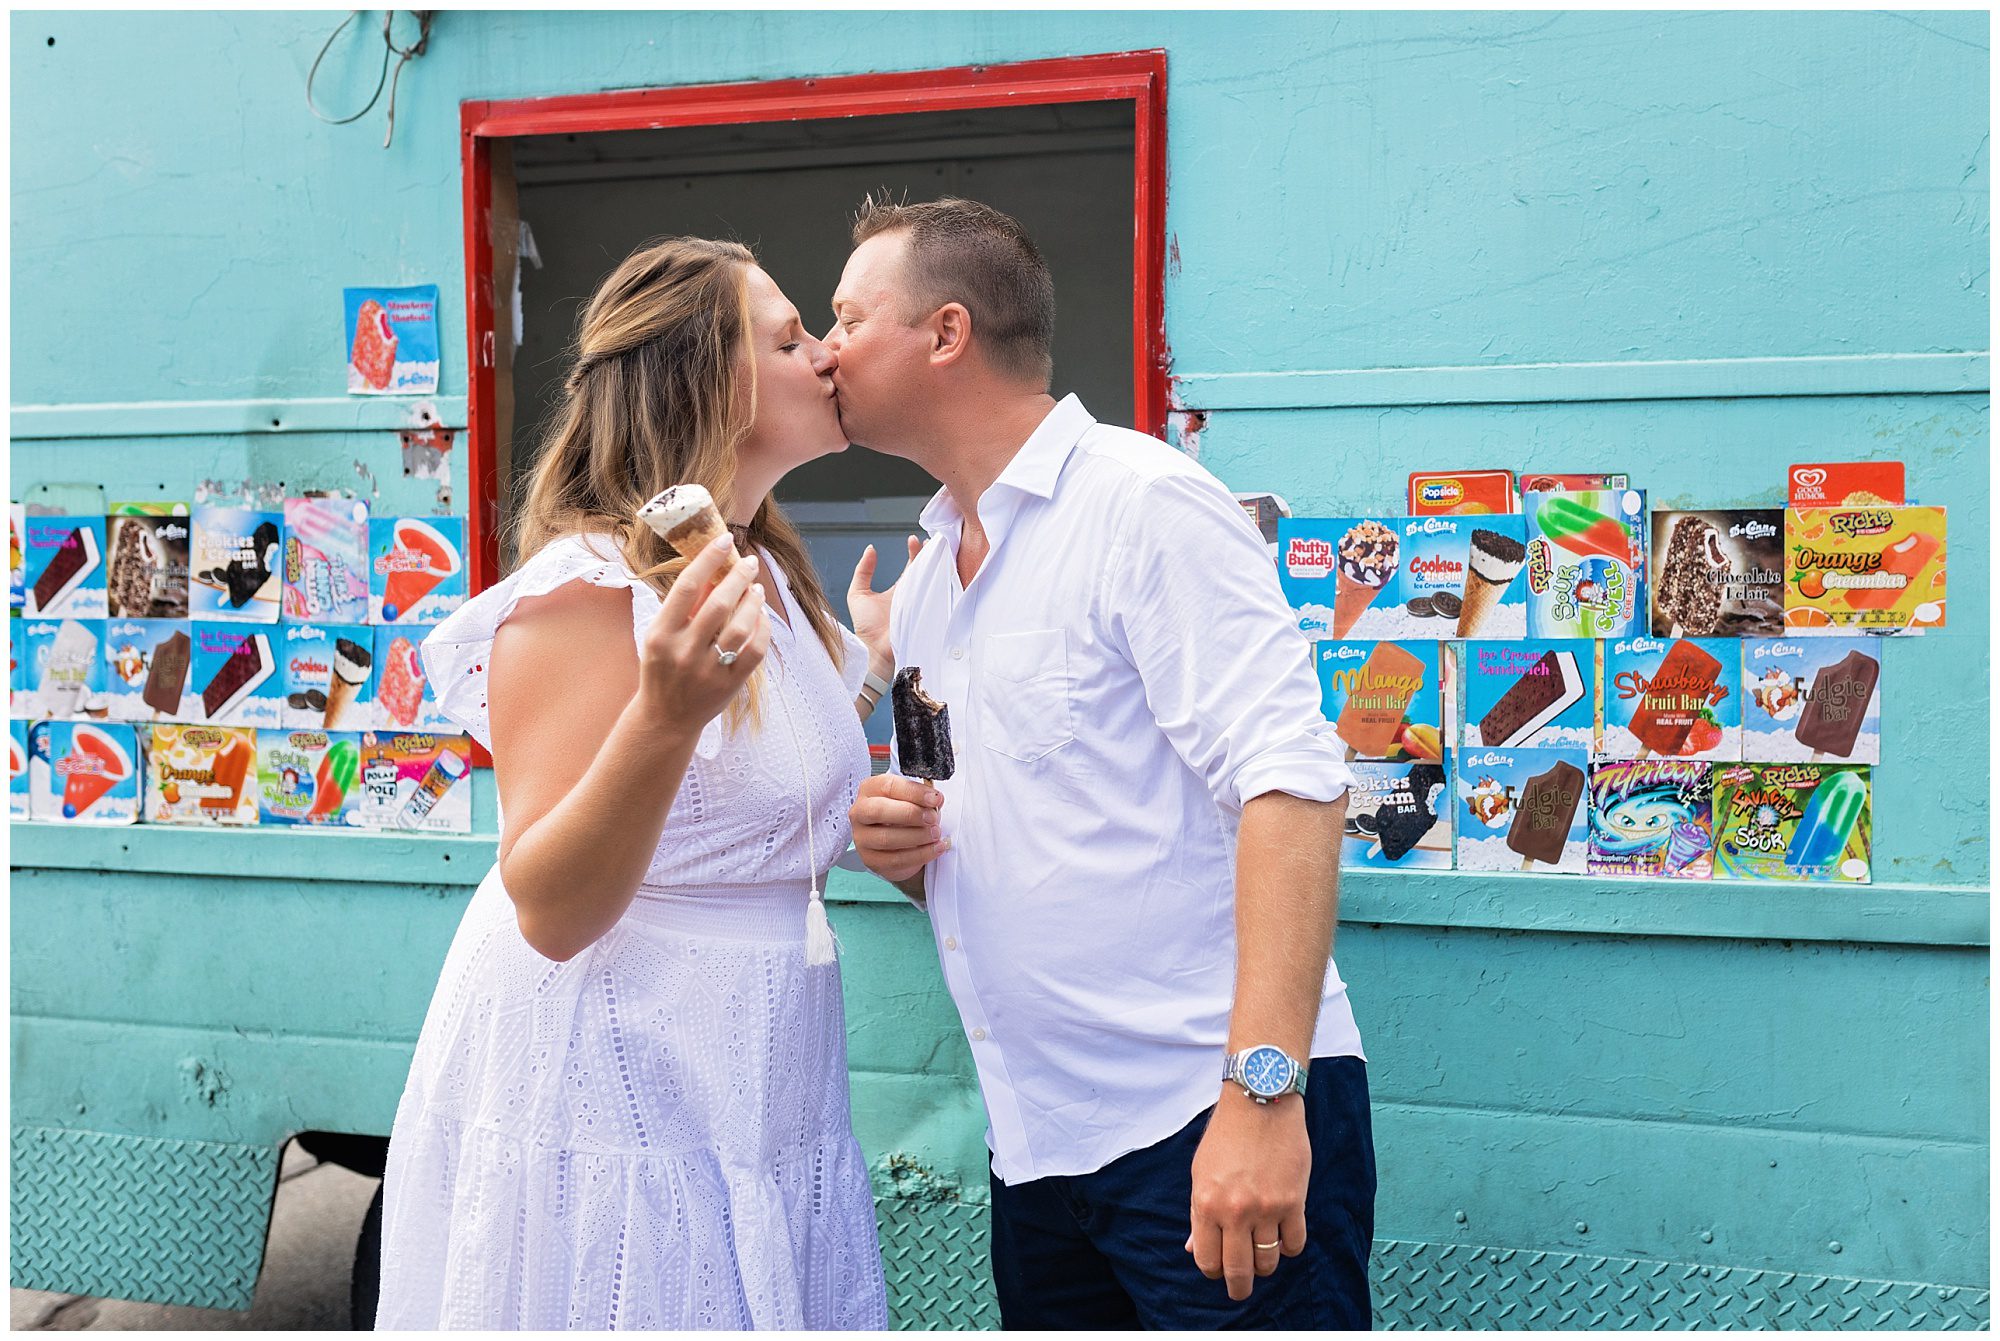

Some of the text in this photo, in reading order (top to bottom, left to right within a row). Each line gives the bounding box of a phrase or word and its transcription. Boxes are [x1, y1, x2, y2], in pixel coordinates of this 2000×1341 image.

[1422, 486, 1459, 499] Popsicle
[1794, 492, 1826, 500] HUMOR
[1832, 510, 1893, 538] Rich's
[1292, 541, 1329, 557] Nutty
[1288, 554, 1333, 569] Buddy
[1409, 554, 1463, 573] Cookies
[1528, 539, 1553, 593] Rich's
[1795, 548, 1882, 573] Orange
[1415, 572, 1425, 582] &
[1706, 567, 1782, 584] Chocolate
[1595, 560, 1624, 632] SWELL
[1726, 585, 1769, 600] Eclair
[1478, 648, 1542, 661] Ice Cream
[1478, 661, 1551, 676] Sandwich
[1332, 664, 1424, 701] Mango
[1614, 663, 1730, 707] Strawberry
[1793, 674, 1867, 708] Fudgie
[1351, 694, 1407, 710] Fruit Bar
[1644, 694, 1704, 710] Fruit Bar
[1822, 703, 1851, 721] Bar
[1348, 774, 1411, 793] okies
[1592, 759, 1708, 812] TYPHOON
[1763, 766, 1820, 790] Rich's
[367, 785, 394, 796] POLE
[1504, 783, 1573, 816] Fudgie
[1349, 791, 1416, 809] Cream
[1397, 804, 1417, 814] BAR
[1731, 789, 1804, 822] SAVAGELY
[1532, 812, 1560, 829] Bar
[1735, 828, 1786, 851] SOUR
[1588, 863, 1656, 875] WATER ICE
